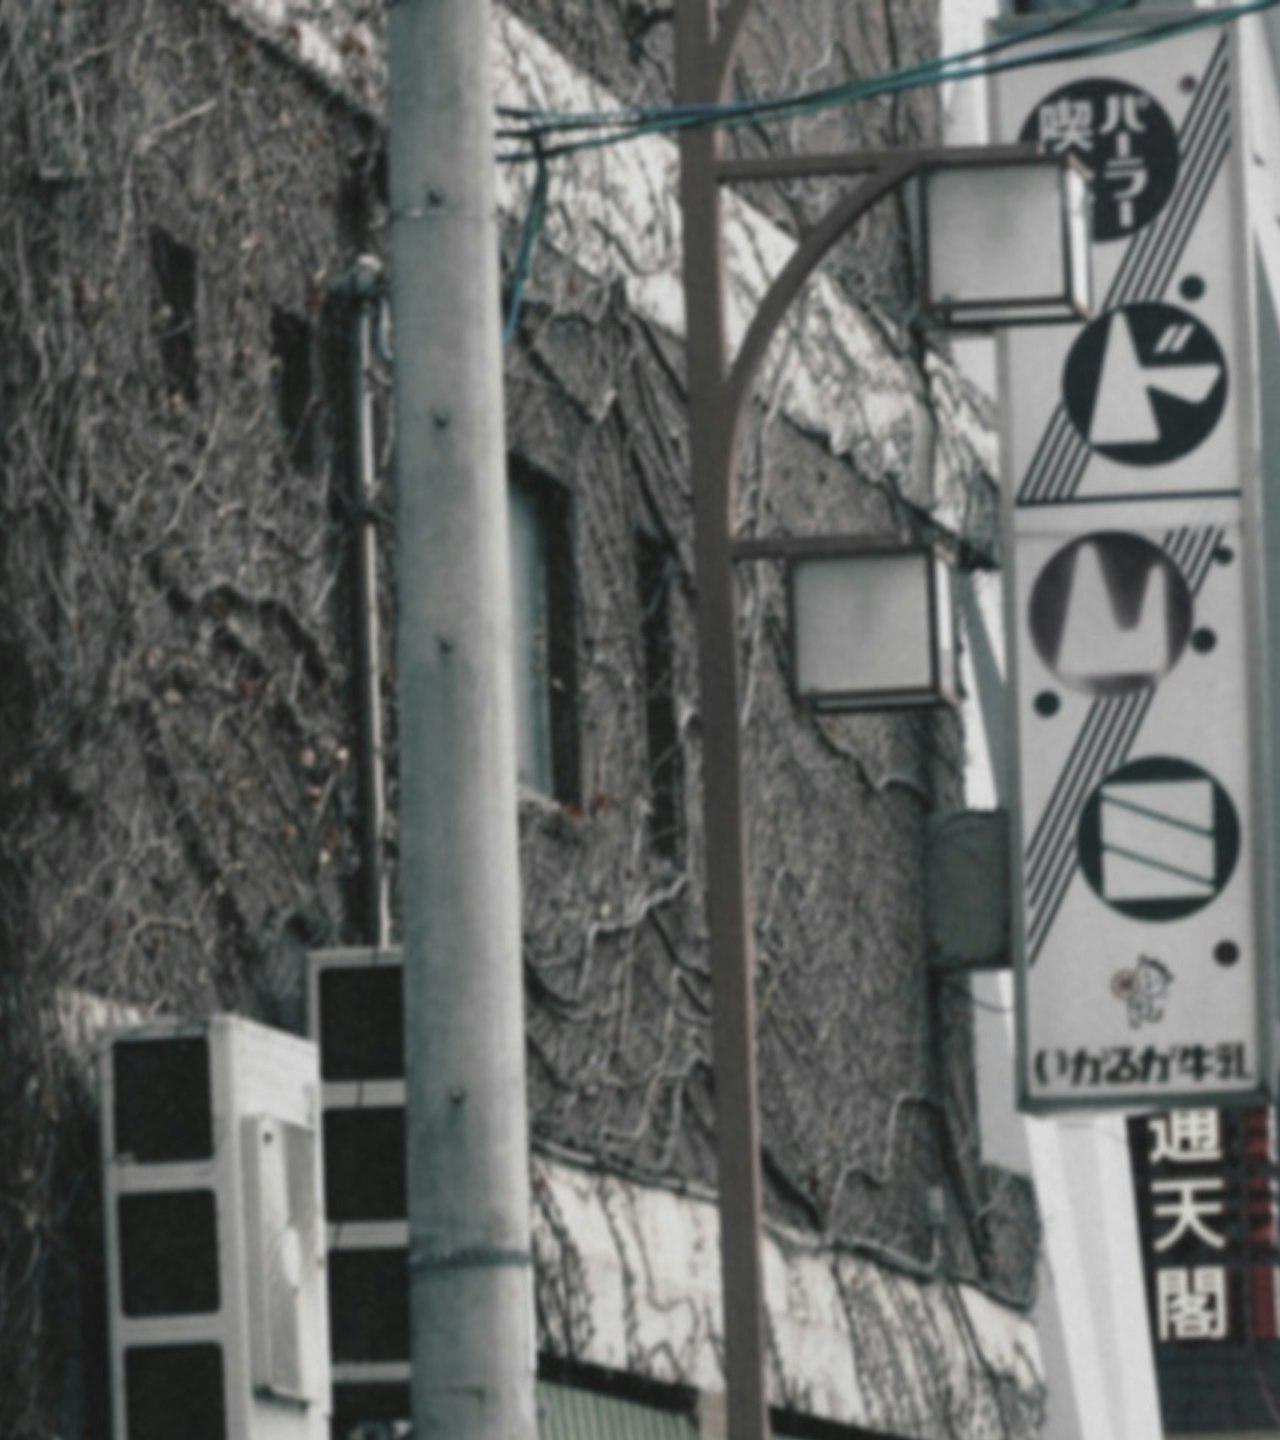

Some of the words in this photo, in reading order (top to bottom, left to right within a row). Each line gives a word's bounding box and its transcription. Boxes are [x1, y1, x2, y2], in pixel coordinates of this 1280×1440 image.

[1034, 1042, 1252, 1087] いかるが牛乳
[1149, 1106, 1226, 1342] 通天閣
